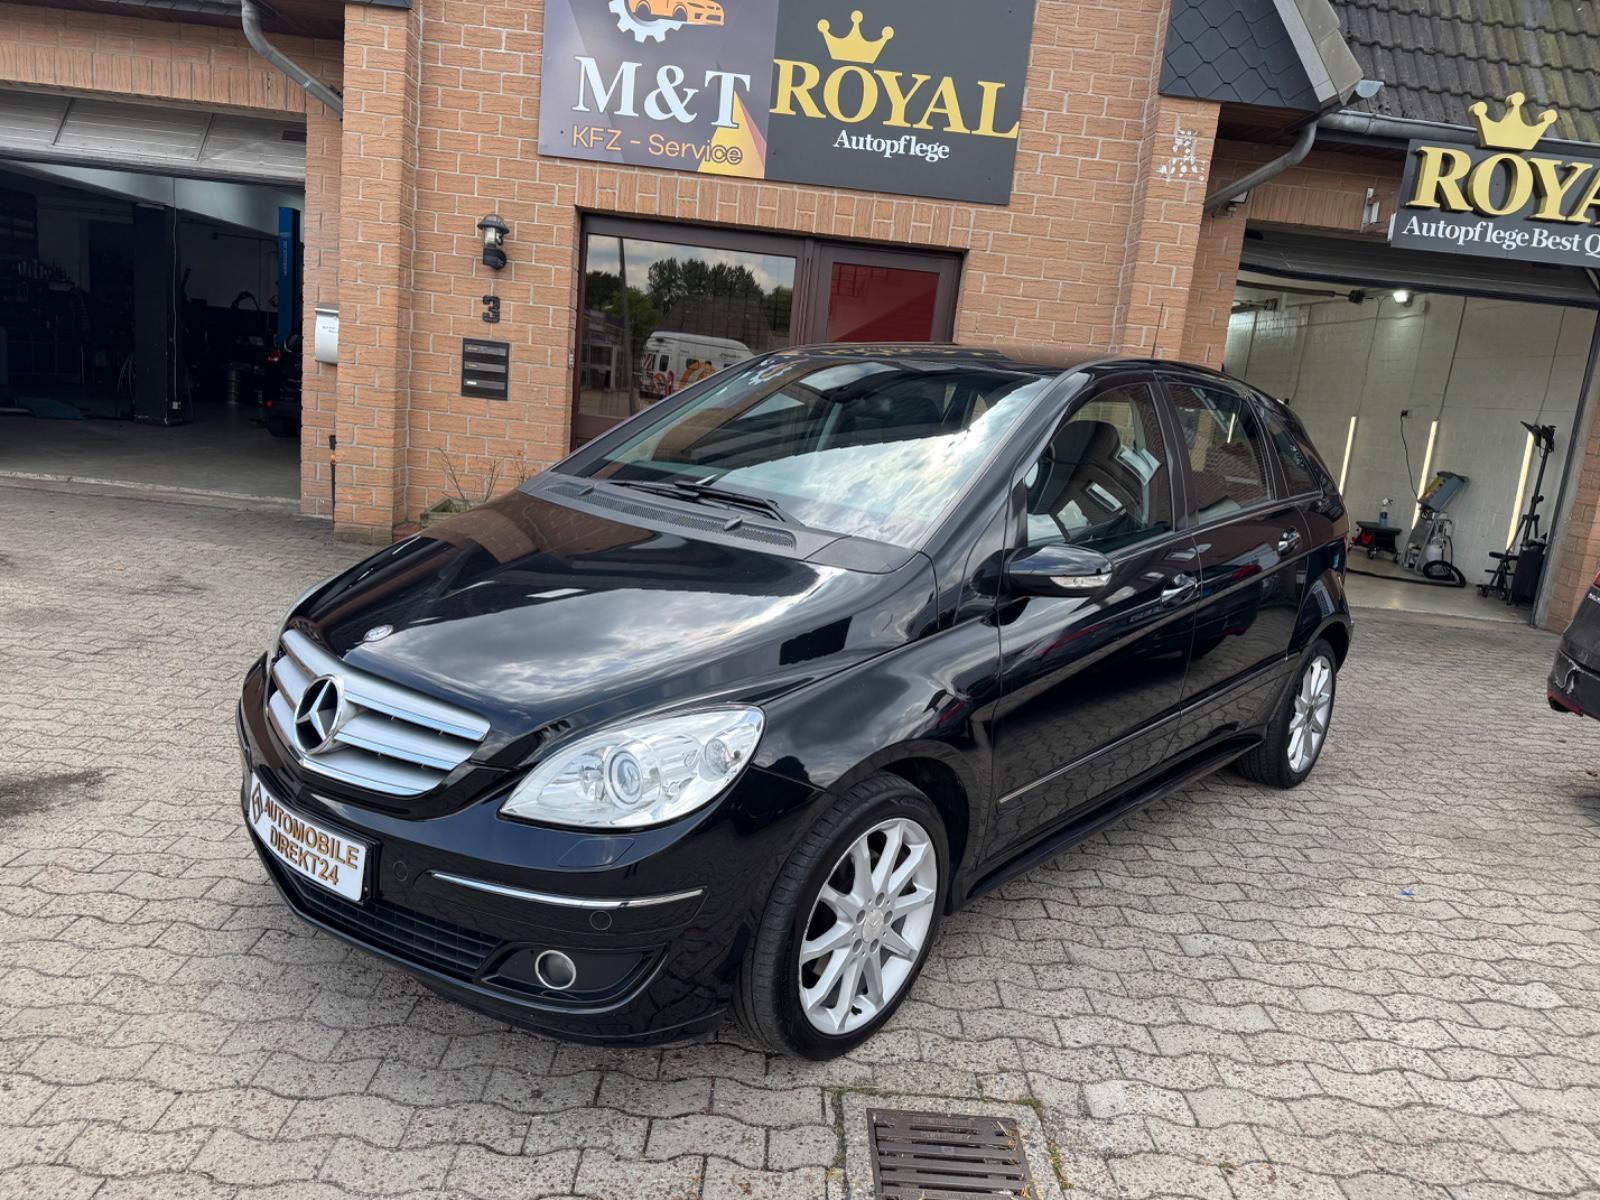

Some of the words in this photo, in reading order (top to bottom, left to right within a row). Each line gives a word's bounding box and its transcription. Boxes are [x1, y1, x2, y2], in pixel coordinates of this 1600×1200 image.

[571, 55, 752, 129] M&T
[768, 58, 1021, 140] ROYAL
[572, 125, 623, 152] KFZ
[648, 133, 744, 165] Service
[832, 129, 950, 163] Autopflege
[1402, 215, 1529, 251] Autopflege
[1531, 227, 1583, 253] Best
[482, 295, 501, 324] 3
[264, 796, 360, 870] AUTOMOBILE
[269, 825, 339, 886] DIREKT24
